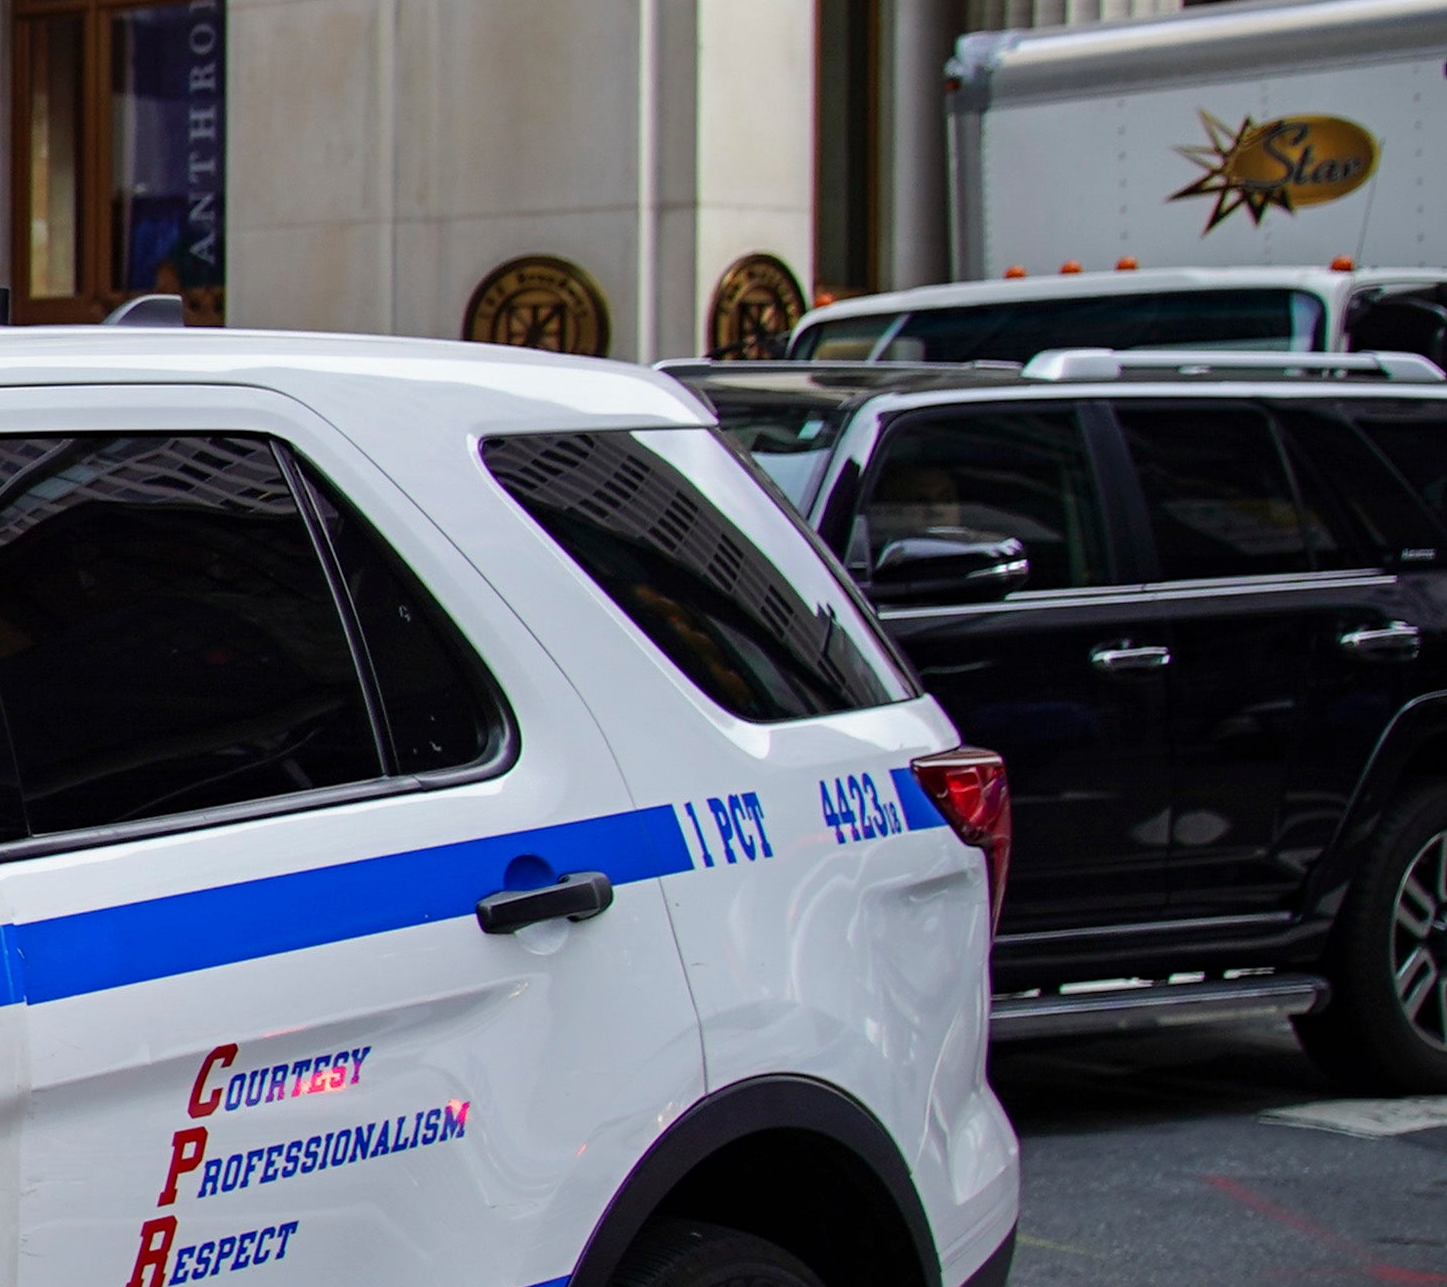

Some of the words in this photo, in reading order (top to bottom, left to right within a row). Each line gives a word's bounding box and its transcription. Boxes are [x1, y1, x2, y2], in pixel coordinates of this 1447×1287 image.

[1242, 120, 1362, 190] Star
[685, 802, 715, 868] 1
[706, 791, 774, 864] PCT
[819, 772, 887, 845] 4423
[187, 1043, 372, 1119] COURTESY
[156, 1100, 471, 1208] PROFESSIONALISM
